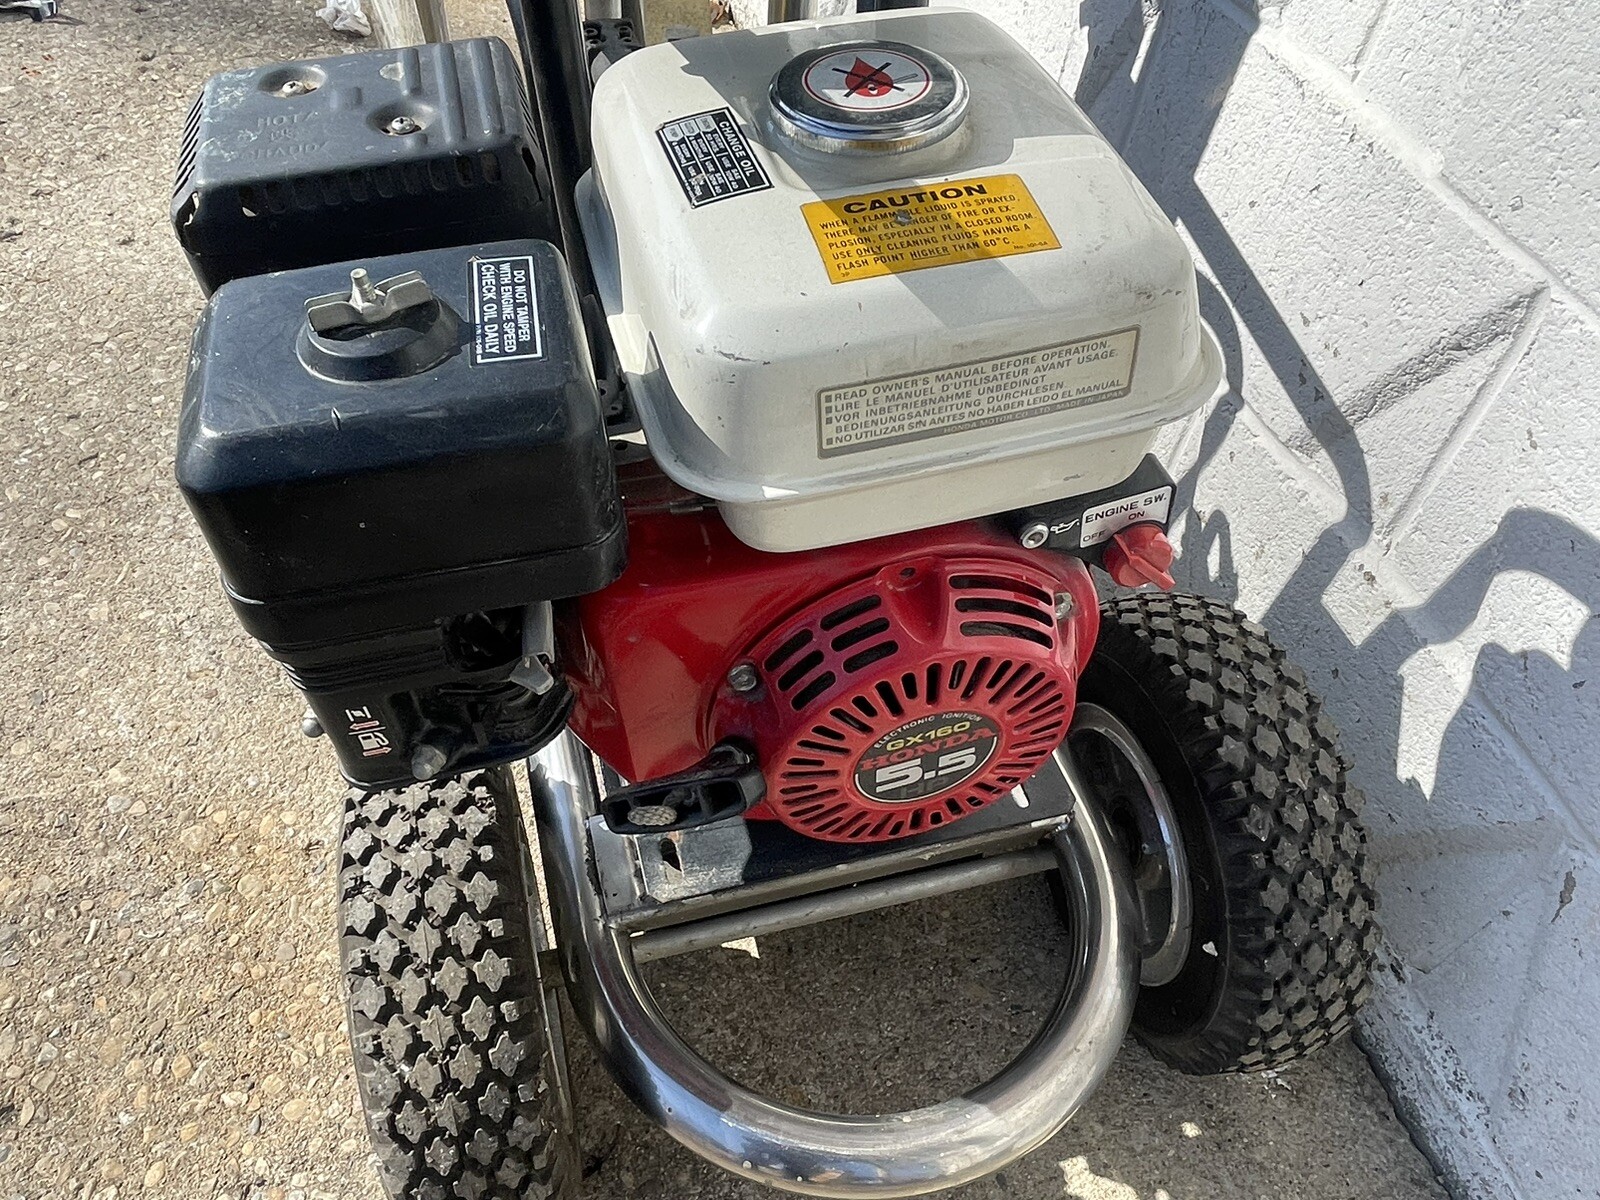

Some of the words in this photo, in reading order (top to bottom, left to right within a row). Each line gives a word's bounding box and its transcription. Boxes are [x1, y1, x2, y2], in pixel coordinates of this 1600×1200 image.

[720, 121, 746, 158] CHANGE
[741, 160, 755, 177] OIL
[843, 184, 987, 214] CAUTION
[819, 219, 848, 230] WHEN
[862, 208, 921, 222] FLAMMLE
[924, 203, 958, 213] LIQUID
[824, 228, 857, 239] THERE
[859, 224, 878, 233] MAY
[900, 215, 938, 227] ANGER
[957, 209, 979, 218] FIRE
[982, 207, 995, 215] OR
[878, 226, 936, 241] ESPECIALLY
[940, 224, 951, 232] IN
[965, 217, 1003, 228] CLOSED
[833, 252, 852, 260] USE
[856, 245, 882, 256] ONLY
[887, 236, 937, 251] CLEANING
[942, 230, 979, 242] FLUIDS
[982, 225, 1020, 236] HAVING
[836, 259, 869, 271] FLASH
[874, 253, 905, 264] POINT
[910, 247, 949, 260] HIGHER
[953, 242, 980, 253] THAN
[481, 264, 496, 301] CHECK
[499, 262, 512, 284] WITH
[514, 270, 525, 283] DO
[501, 286, 514, 320] ENGINE
[515, 285, 527, 303] NOT
[483, 303, 498, 322] OIL
[516, 305, 530, 341] TAMPER
[484, 324, 500, 354] DAILY
[503, 322, 516, 353] SPEED
[834, 389, 867, 401] READ
[873, 377, 930, 395] OWNER'S
[934, 367, 987, 383] MANUAL
[991, 356, 1037, 371] BEFORE
[1041, 341, 1111, 362] OPERATION.
[834, 400, 860, 413] LIRE
[866, 396, 879, 407] LE
[885, 385, 935, 403] MANUEL
[941, 367, 1028, 393] D'UTILISATEUR
[1034, 359, 1072, 374] AVANT
[1077, 349, 1118, 365] USAGE.
[834, 412, 860, 423] VOR
[866, 390, 972, 417] INBETRIEBNAHME
[978, 374, 1047, 396] UNBEDINGT
[943, 421, 978, 433] HONDA
[980, 414, 1012, 427] MOTOR
[1056, 400, 1081, 410] MADE
[1098, 390, 1124, 401] JAPAN
[835, 400, 981, 434] BEDIENUNGSANLEITUNG
[835, 435, 852, 444] NO
[855, 425, 905, 441] UTILIZAR
[908, 420, 927, 430] SIN
[929, 412, 965, 427] ANTES
[968, 408, 985, 418] NO
[987, 399, 1024, 414] HABER
[1027, 393, 1059, 406] LEIDO
[1061, 390, 1073, 399] EL
[1085, 501, 1139, 523] ENGINE
[1143, 493, 1167, 507] SW.
[1128, 511, 1146, 520] ON
[1082, 530, 1107, 542] OFF
[873, 715, 936, 749] ELECTRONIC
[942, 712, 983, 722] IGNITION
[886, 721, 971, 751] GX160
[861, 728, 997, 771] HONDA
[876, 747, 976, 793] 5.5
